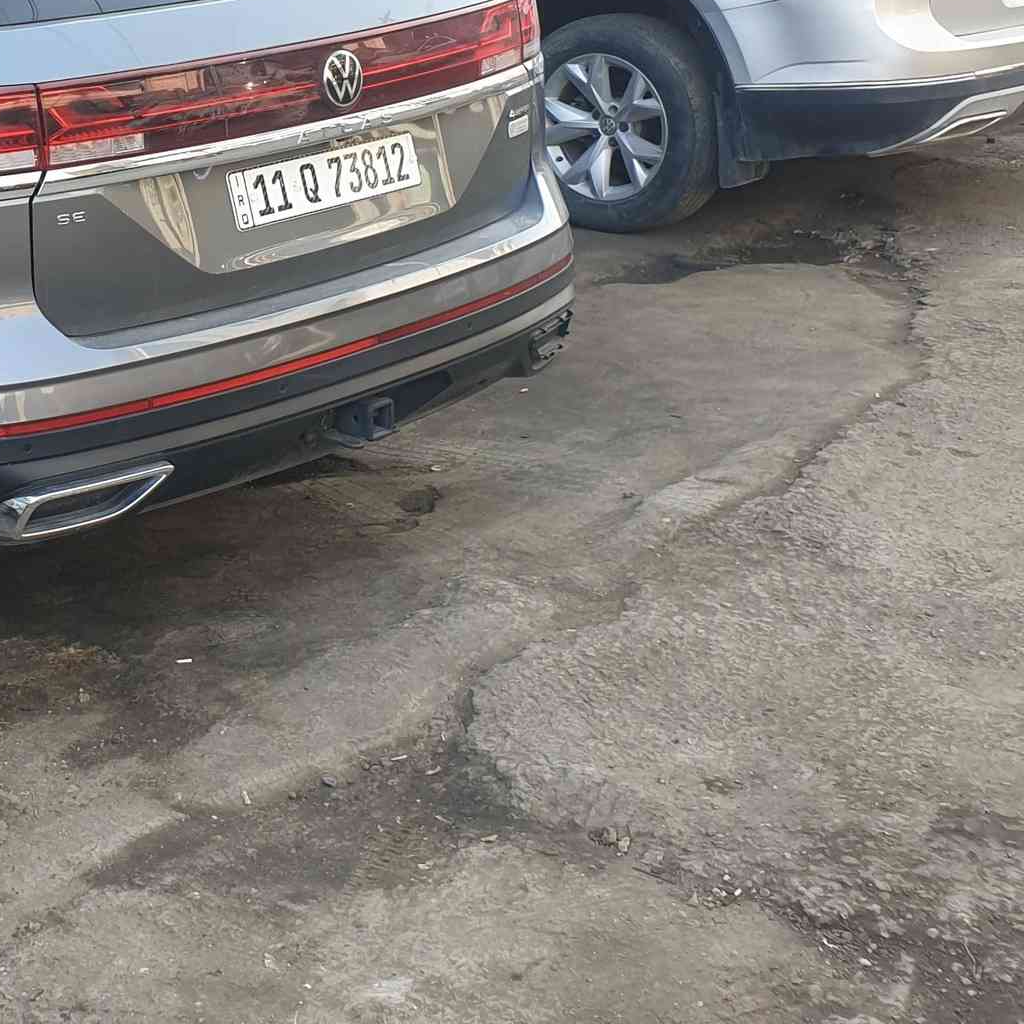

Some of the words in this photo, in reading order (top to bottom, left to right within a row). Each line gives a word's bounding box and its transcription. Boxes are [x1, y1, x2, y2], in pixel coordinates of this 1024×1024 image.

[253, 169, 293, 217] 11
[299, 162, 322, 203] Q
[326, 142, 411, 198] 73812
[56, 211, 86, 225] SE
